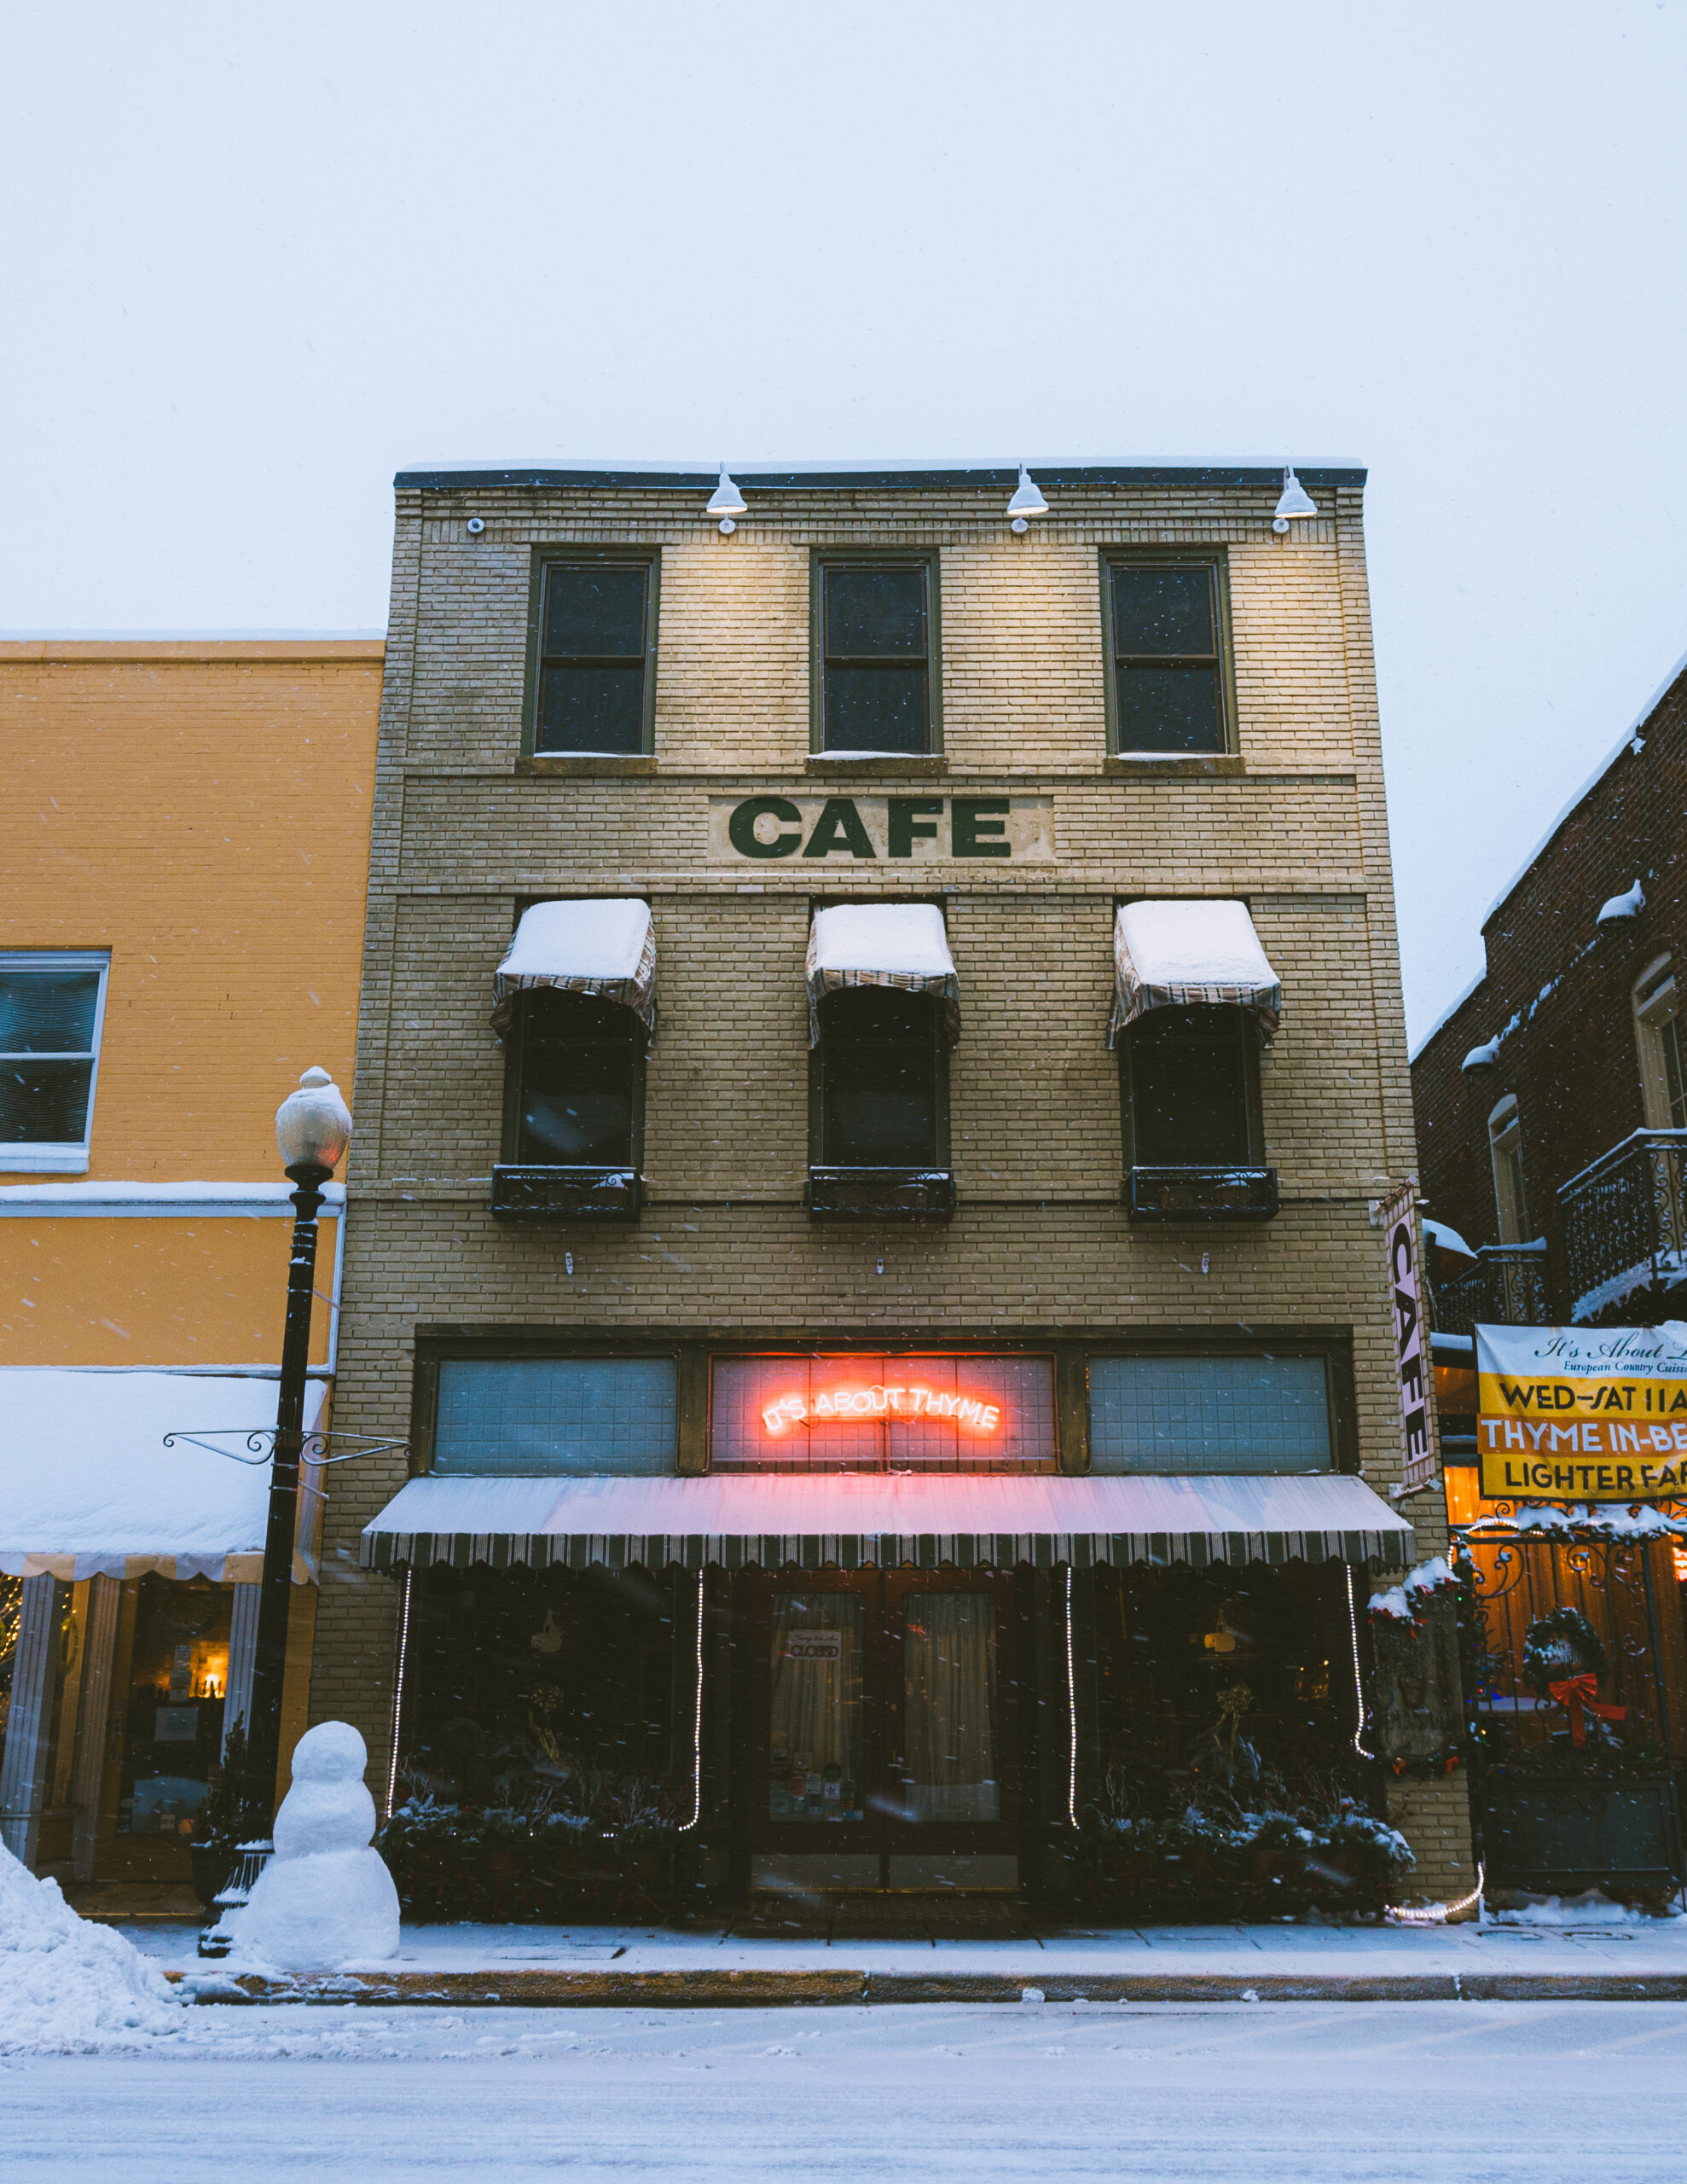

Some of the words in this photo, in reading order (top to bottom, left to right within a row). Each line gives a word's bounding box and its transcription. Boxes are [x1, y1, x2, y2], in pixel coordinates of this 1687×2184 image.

[728, 796, 1011, 858] CAFE
[1392, 1223, 1429, 1462] CAFE
[1534, 1336, 1580, 1357] It's
[1587, 1332, 1664, 1359] About
[1564, 1361, 1611, 1374] European
[1615, 1361, 1654, 1374] Country
[762, 1397, 807, 1431] IT'S
[815, 1388, 906, 1413] ABOUT
[909, 1388, 1000, 1430] THYME
[1481, 1419, 1603, 1452] THYME
[1505, 1461, 1635, 1490] LIGHTER
[790, 1645, 839, 1658] CLOSED
